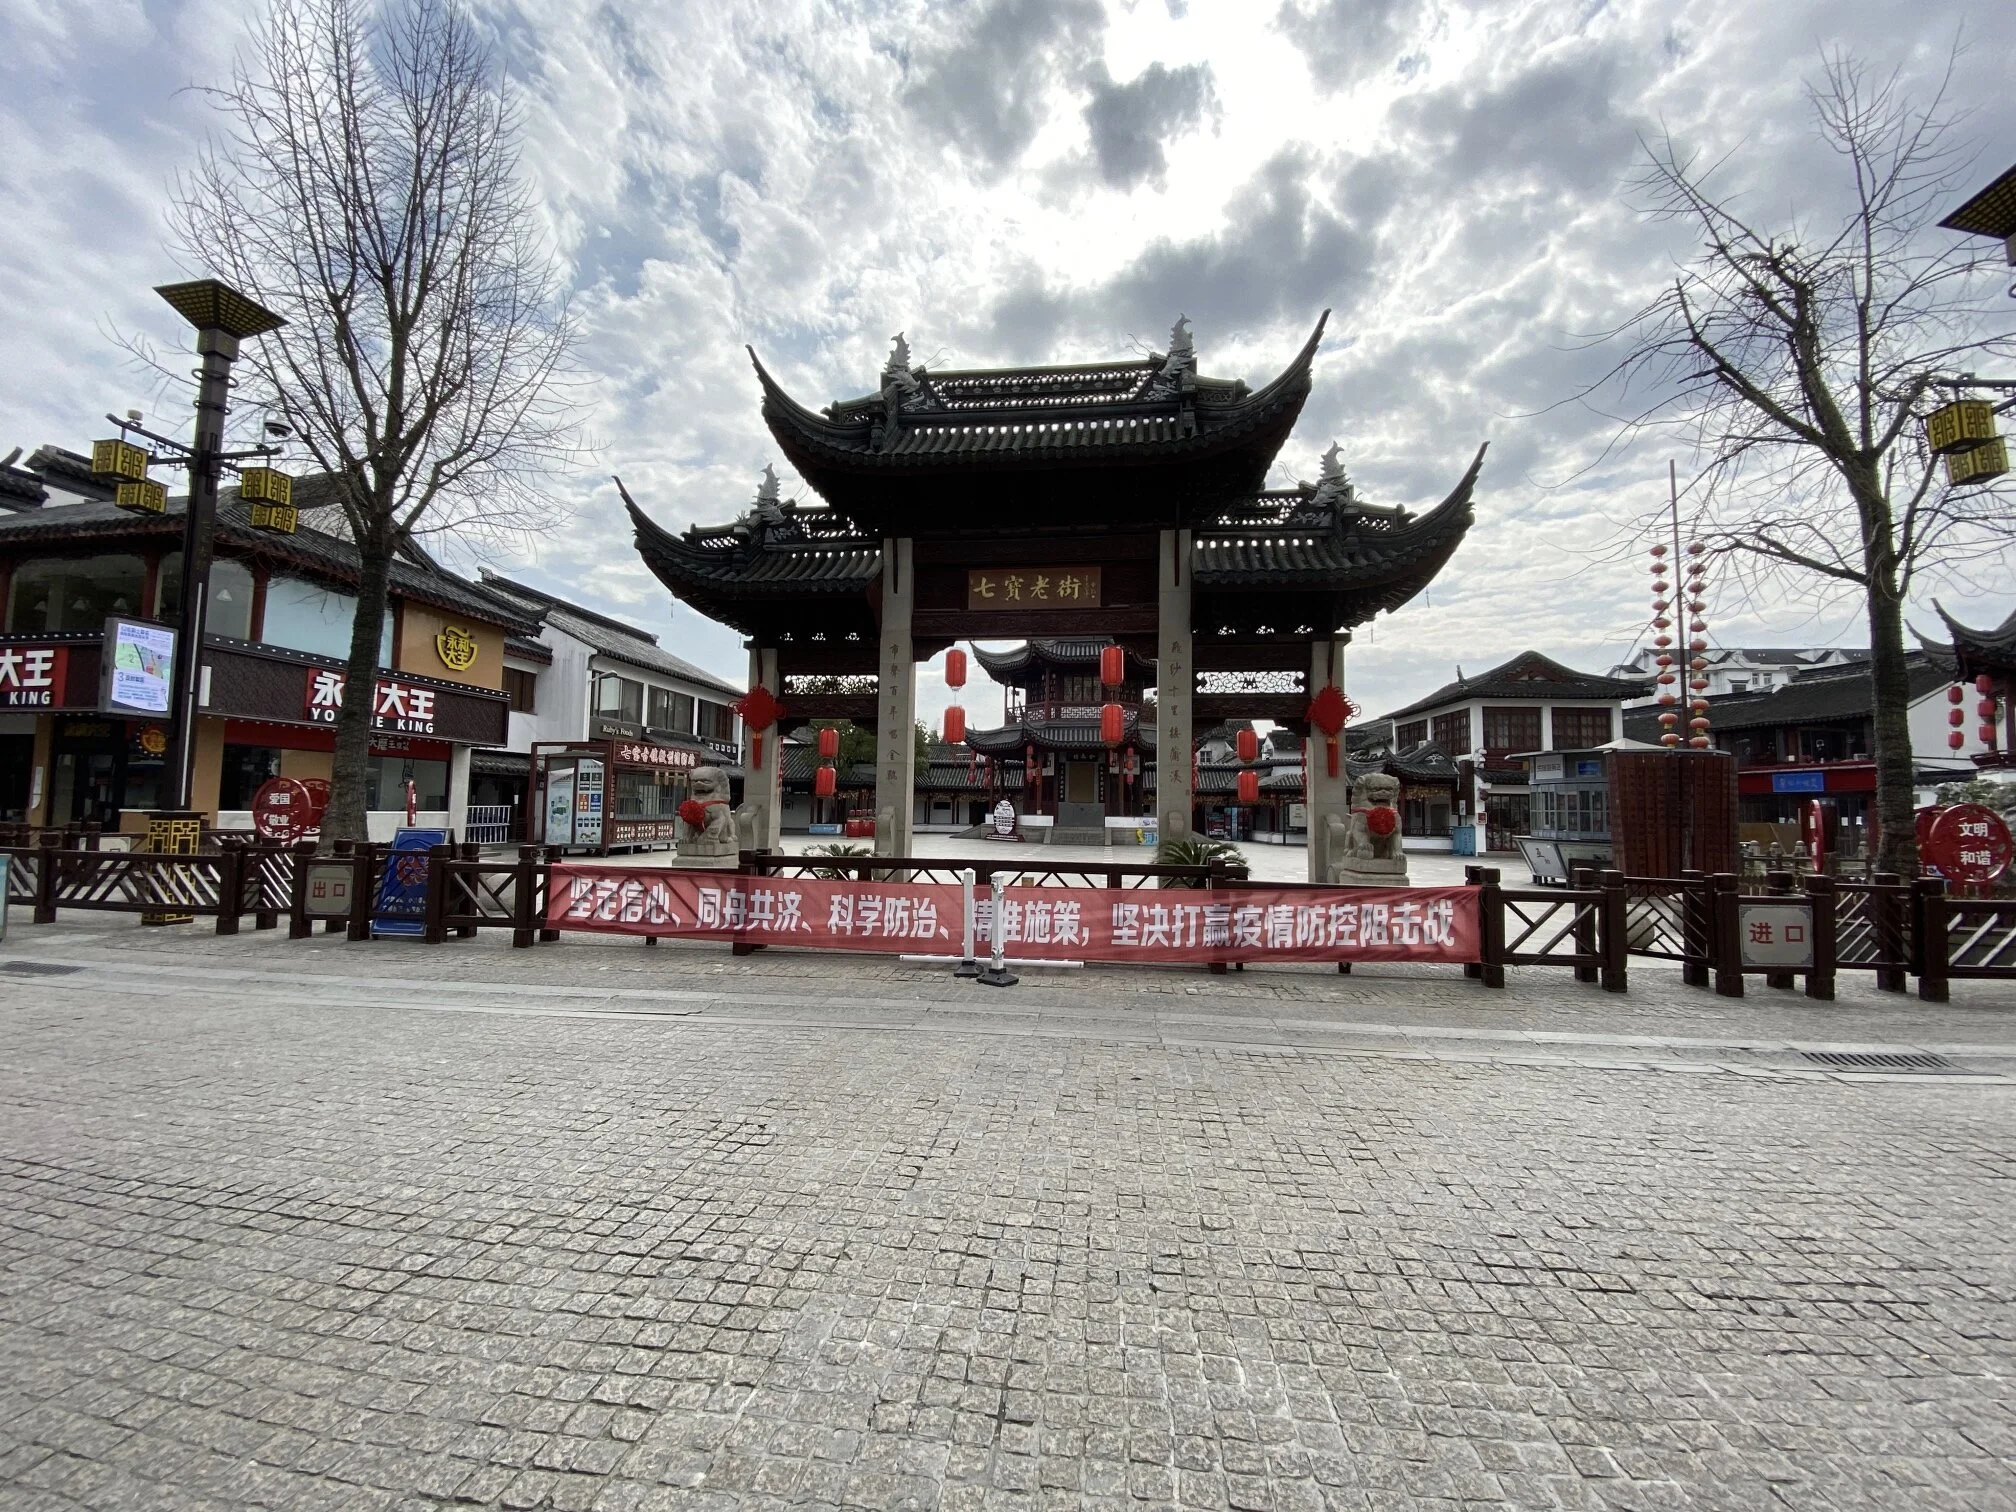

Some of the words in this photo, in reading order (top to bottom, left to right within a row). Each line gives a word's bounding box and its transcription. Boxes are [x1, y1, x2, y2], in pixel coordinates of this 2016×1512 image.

[973, 575, 1082, 601] 七寶老街
[0, 648, 54, 687] 大王
[9, 690, 51, 705] KING
[312, 671, 435, 720] 永大王
[397, 718, 434, 734] KING
[602, 724, 620, 736] Ruby's
[620, 728, 634, 737] Foods
[269, 792, 291, 806] 爱国
[1959, 822, 1989, 838] 文明
[1960, 851, 1991, 866] 和谐
[312, 880, 346, 898] 出口
[1748, 922, 1804, 944] 进口
